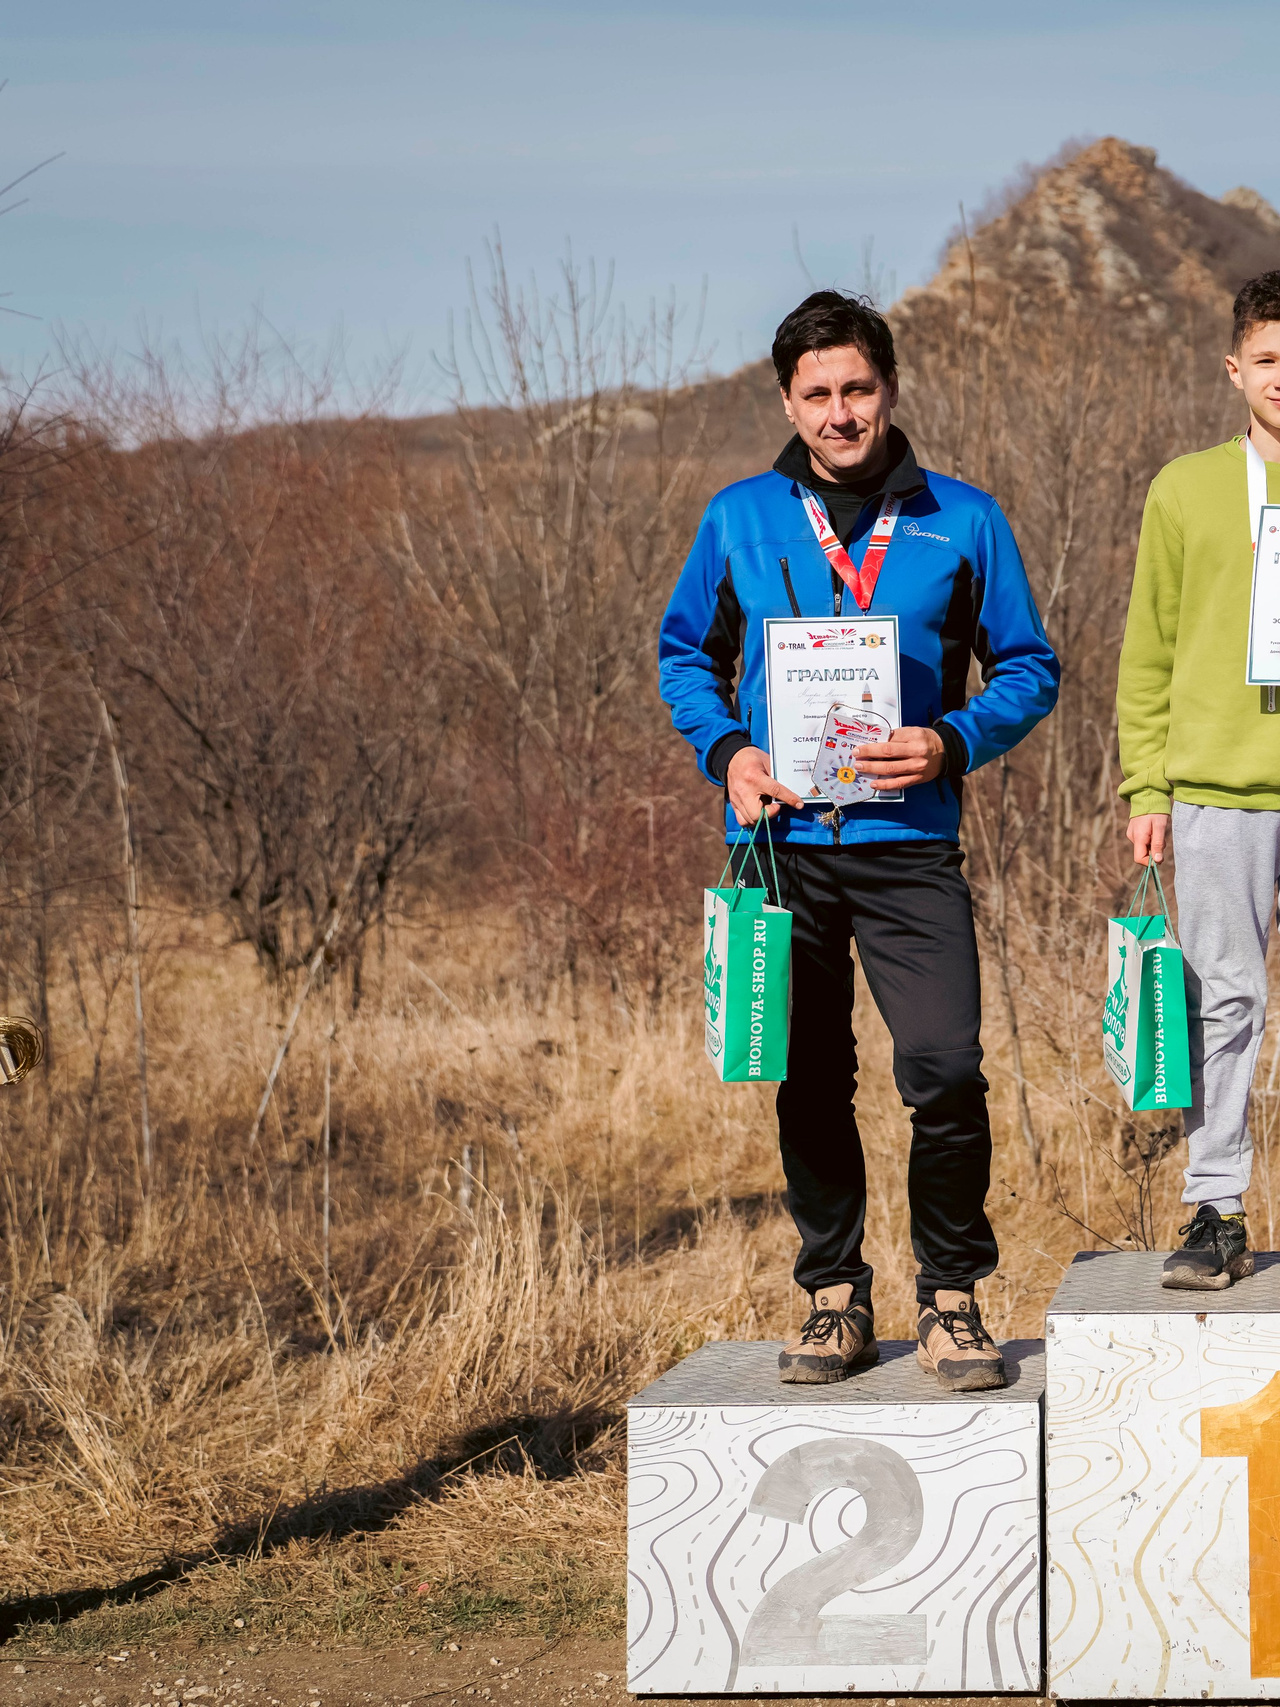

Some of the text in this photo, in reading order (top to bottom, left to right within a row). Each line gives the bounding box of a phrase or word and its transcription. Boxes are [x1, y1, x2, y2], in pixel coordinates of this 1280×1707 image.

[912, 531, 950, 543] NORD
[787, 668, 879, 682] ГРАМОТА
[749, 919, 767, 1077] BIONOVA-SHOP.RU
[1153, 953, 1167, 1103] BIONOVA-SHOP.RU
[742, 1437, 928, 1668] 2
